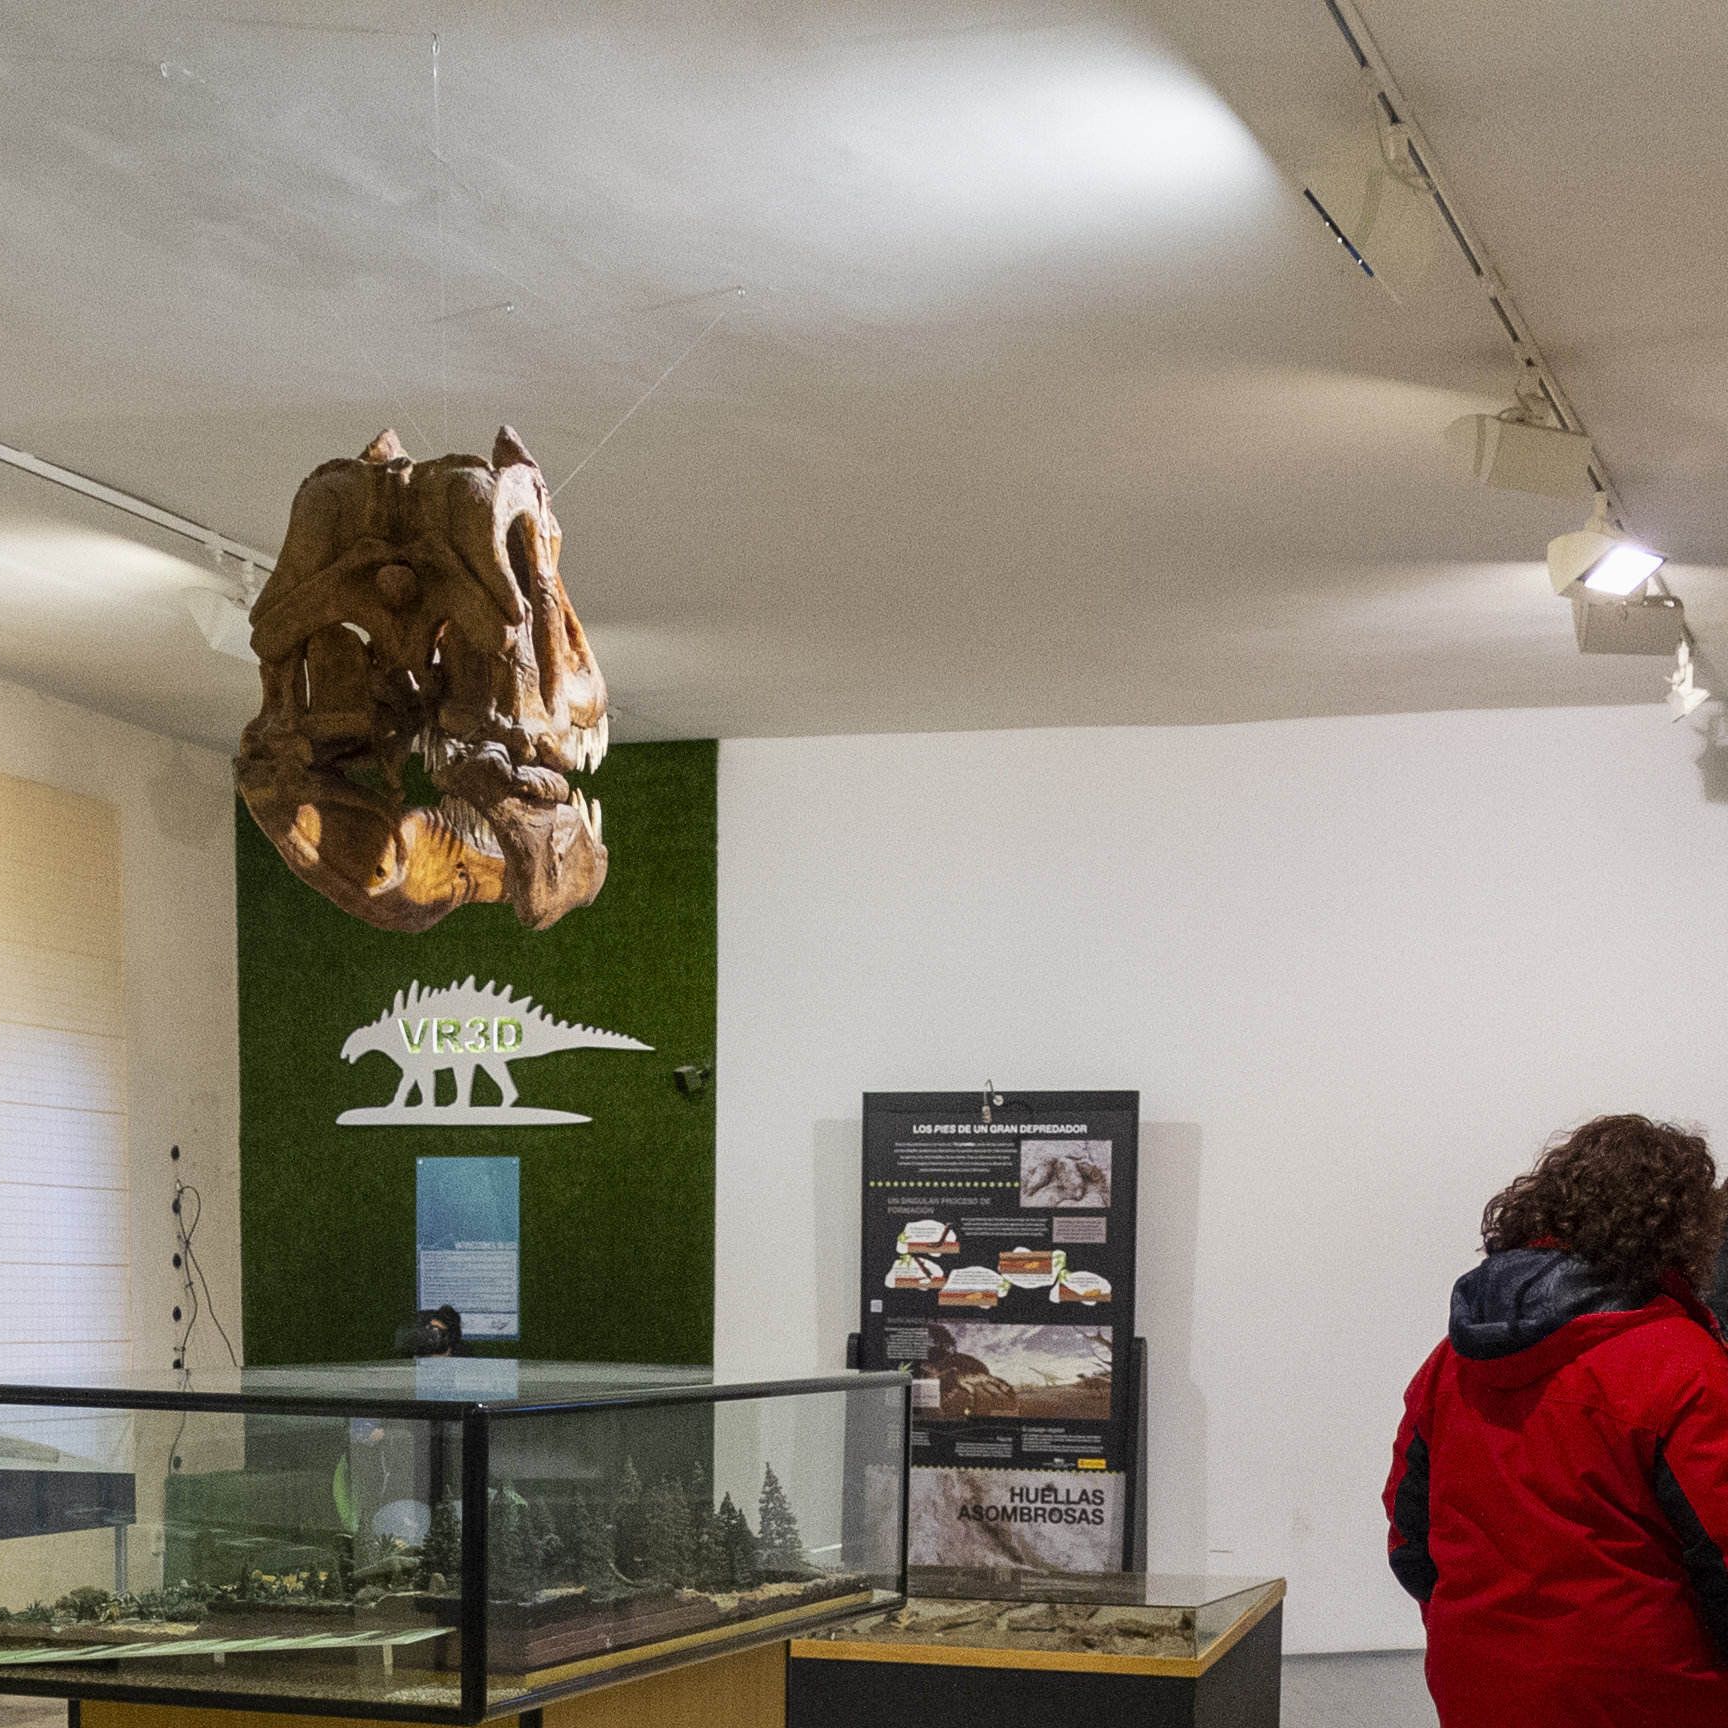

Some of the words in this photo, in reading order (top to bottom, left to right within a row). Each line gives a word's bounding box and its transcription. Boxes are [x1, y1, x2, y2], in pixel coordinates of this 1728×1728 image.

[398, 1017, 523, 1054] VR3D
[913, 1124, 932, 1134] LOS
[934, 1124, 956, 1134] PIES
[958, 1124, 972, 1134] DE
[974, 1124, 988, 1134] UN
[990, 1124, 1018, 1134] GRAN
[1020, 1124, 1088, 1134] DEPREDADOR
[1010, 1486, 1104, 1506] HUELLAS
[957, 1504, 1104, 1525] ASOMBROSAS
